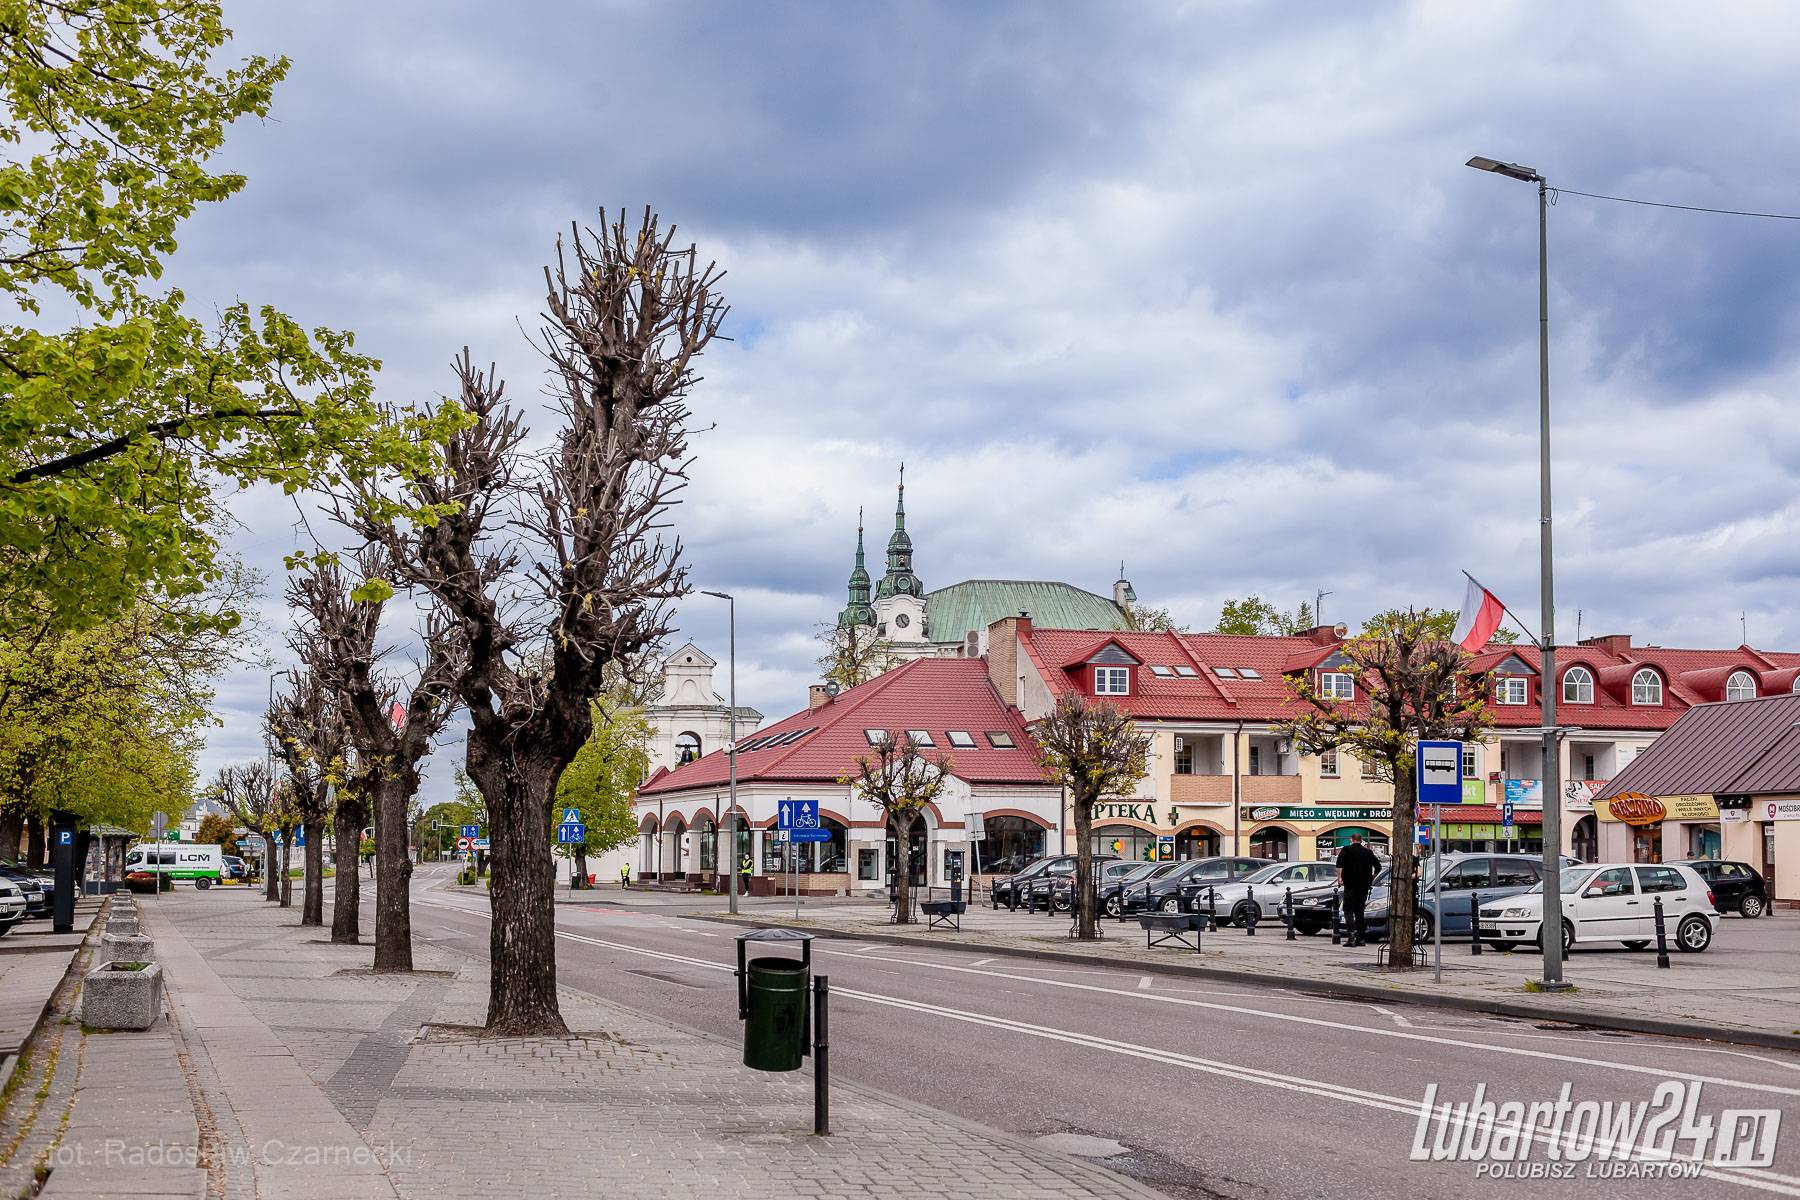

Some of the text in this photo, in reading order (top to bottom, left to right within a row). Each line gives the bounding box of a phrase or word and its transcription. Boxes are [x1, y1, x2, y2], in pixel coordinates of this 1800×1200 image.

[1092, 803, 1157, 825] PTEKA
[1289, 807, 1392, 819] MIĘSO WĘDLINY DRÓB
[1504, 805, 1512, 820] P
[61, 832, 71, 843] P
